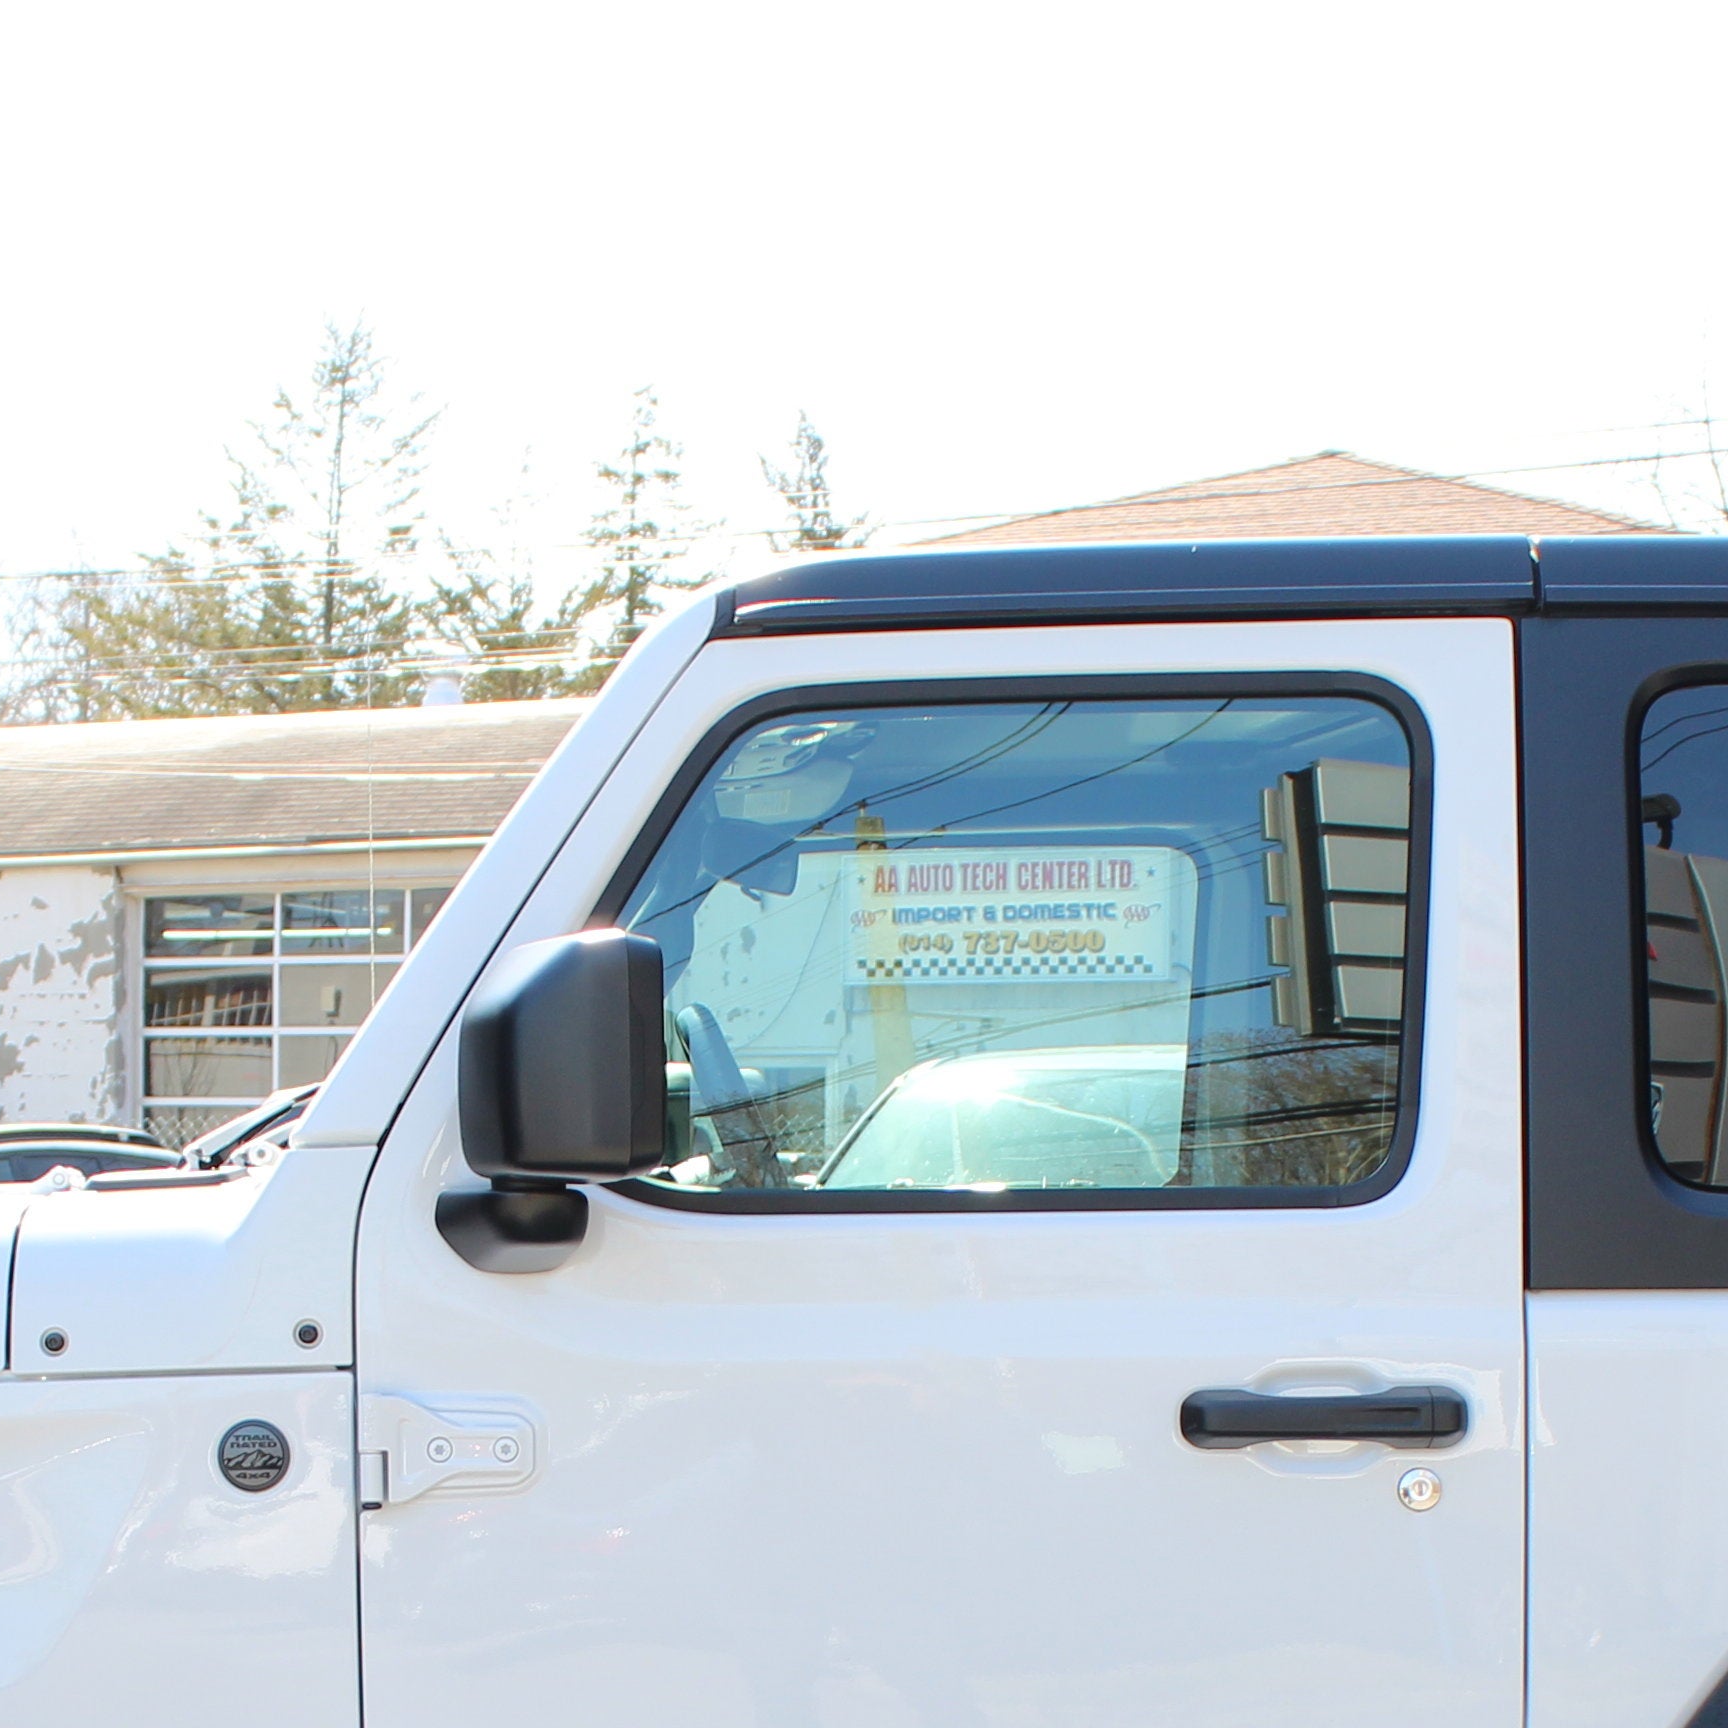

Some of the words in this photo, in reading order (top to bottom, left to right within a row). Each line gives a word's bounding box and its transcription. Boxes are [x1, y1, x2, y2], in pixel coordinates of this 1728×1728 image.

[874, 865, 898, 893] AA
[907, 862, 954, 892] AUTO
[960, 861, 1008, 892] TECH
[1017, 859, 1090, 891] CENTER
[1097, 859, 1138, 889] LTD.
[892, 905, 977, 925] IMPORT
[983, 904, 997, 922] &
[1003, 901, 1119, 921] DOMESTIC
